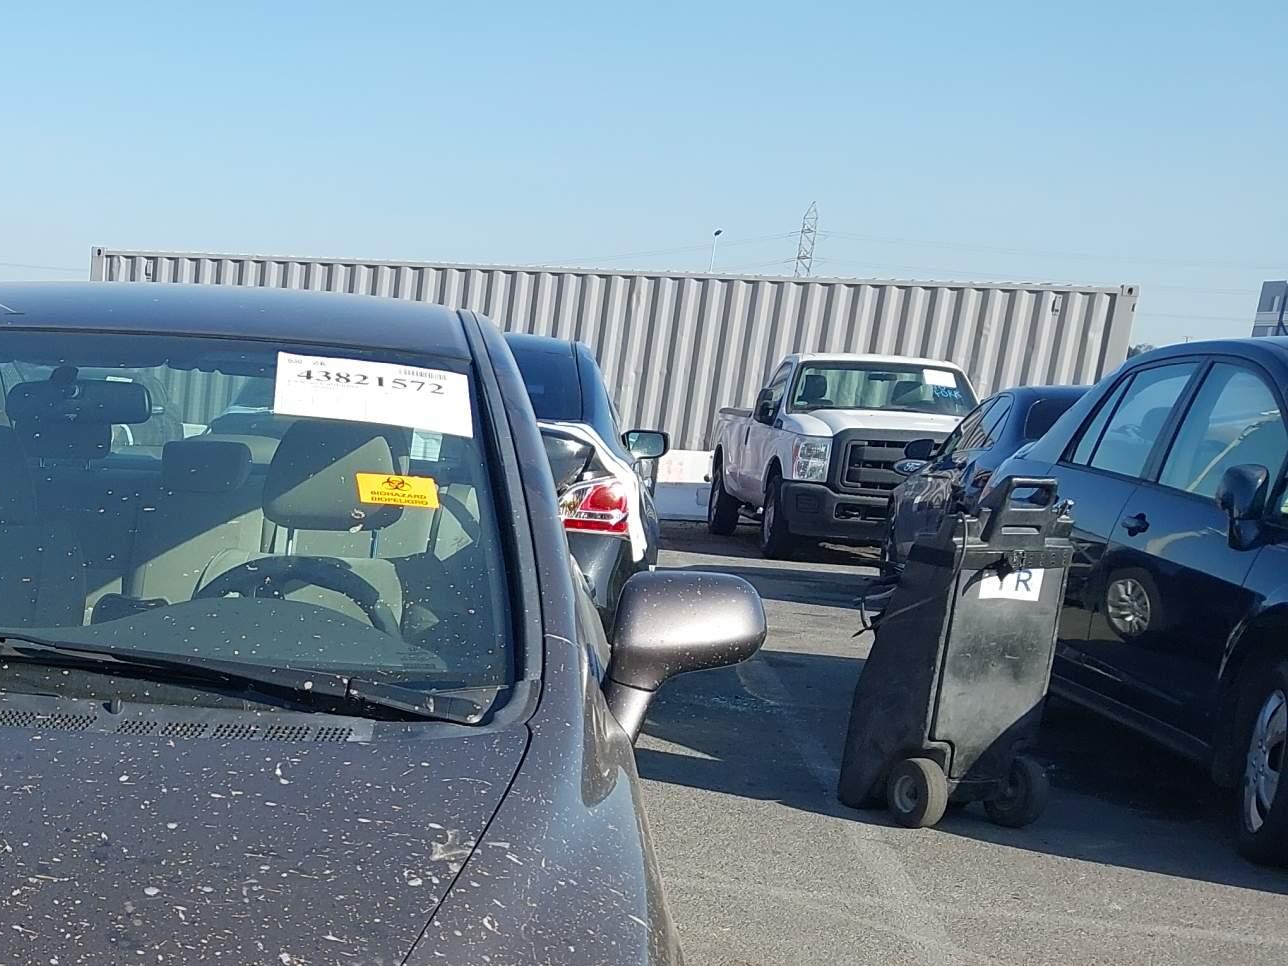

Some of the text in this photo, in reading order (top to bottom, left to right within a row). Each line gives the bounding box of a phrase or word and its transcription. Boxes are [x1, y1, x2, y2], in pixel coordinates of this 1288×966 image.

[296, 369, 446, 396] 43821572
[370, 490, 427, 500] BIOHAZARD
[370, 496, 429, 506] BIOPELIGRO
